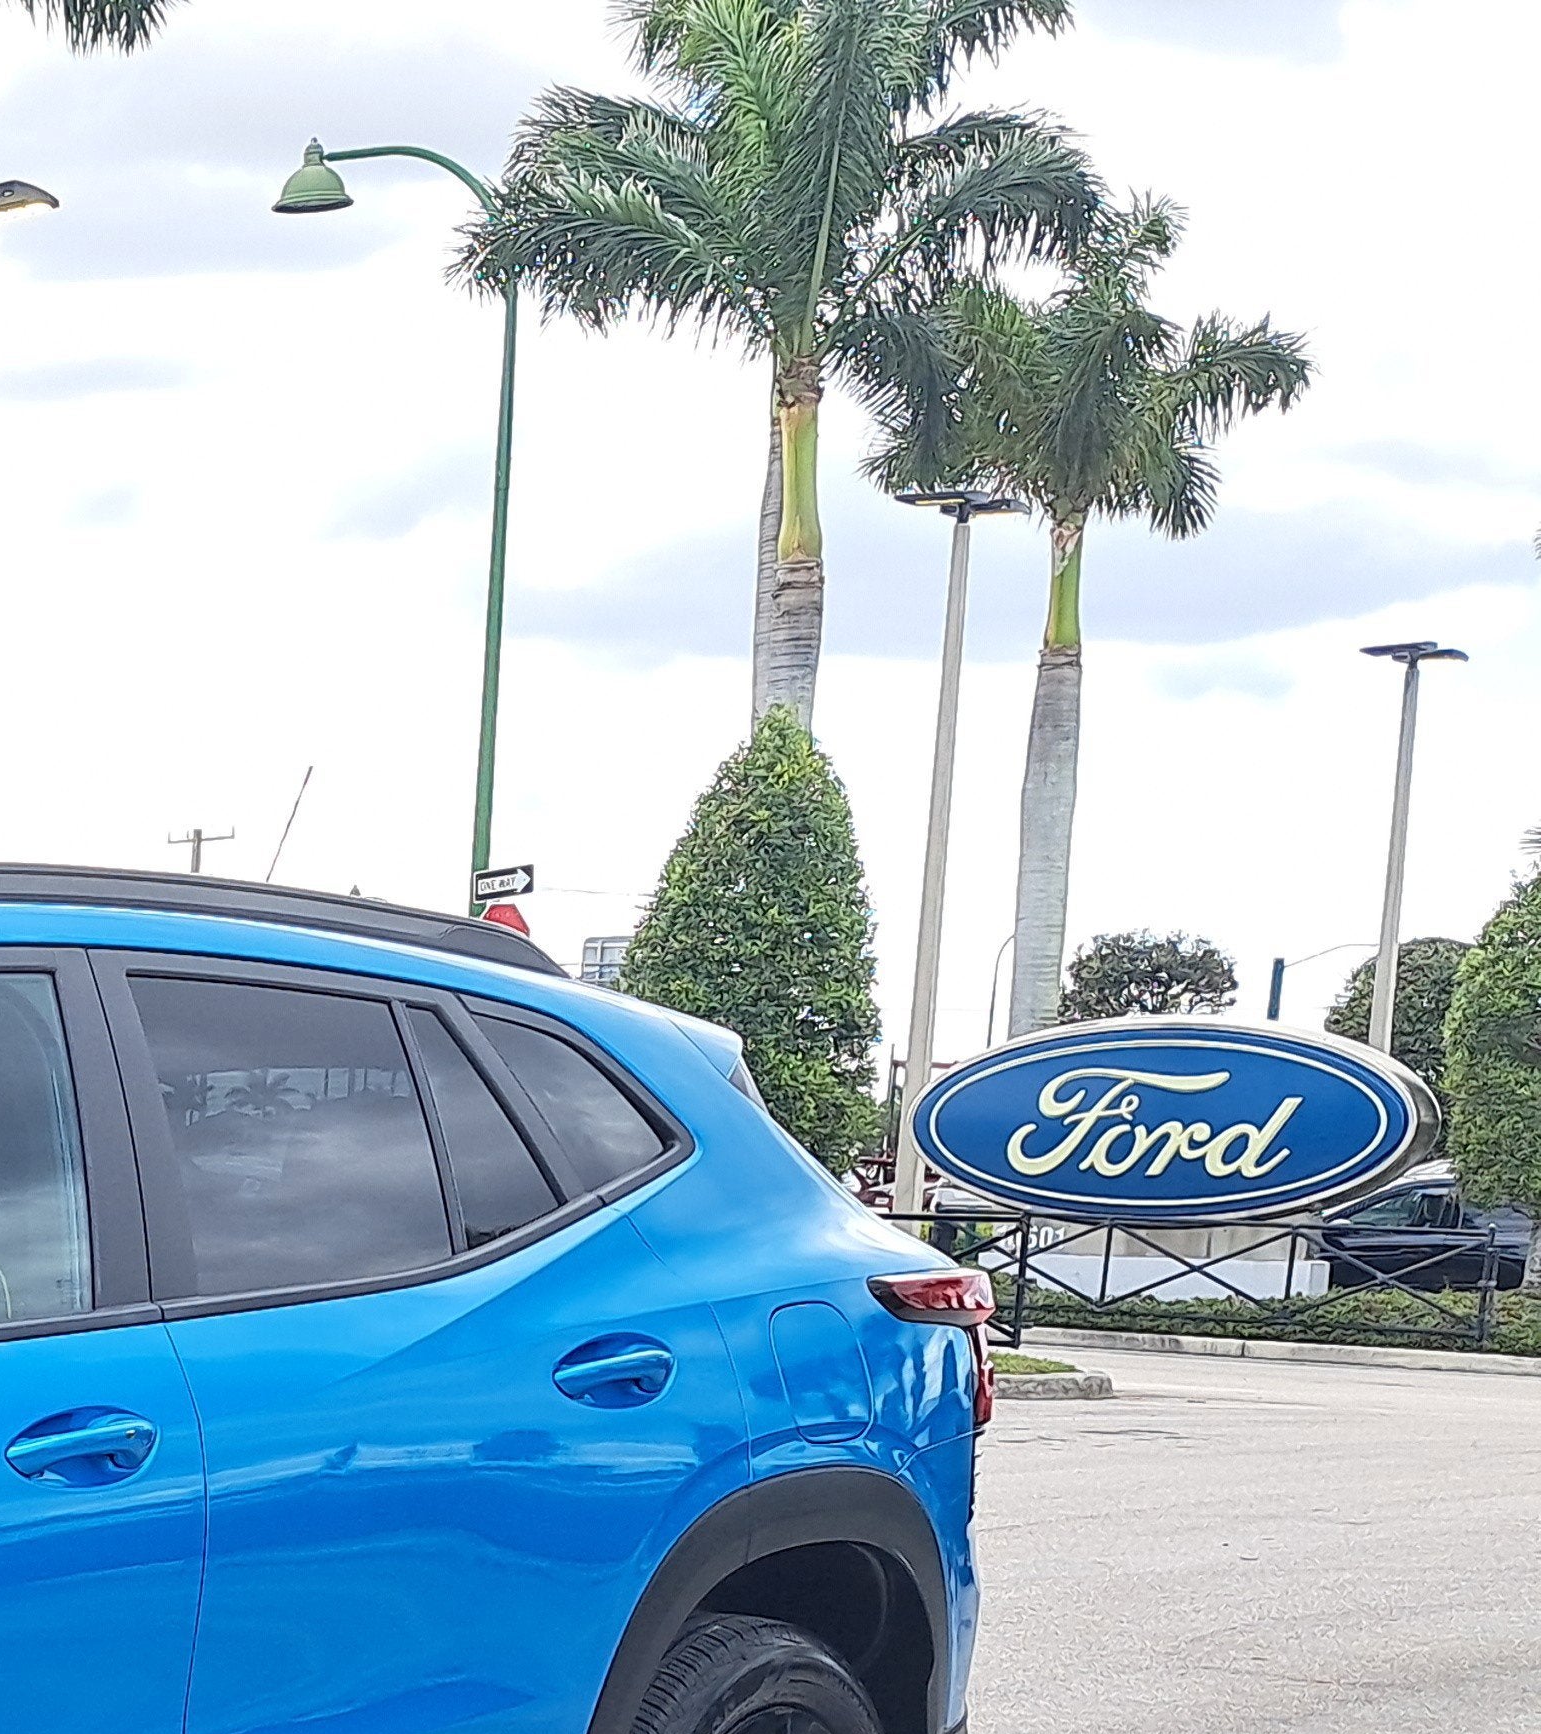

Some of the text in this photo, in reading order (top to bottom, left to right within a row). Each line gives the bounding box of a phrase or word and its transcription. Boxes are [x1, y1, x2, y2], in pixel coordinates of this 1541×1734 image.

[480, 876, 517, 892] ONE WAY
[1008, 1067, 1304, 1178] Ford
